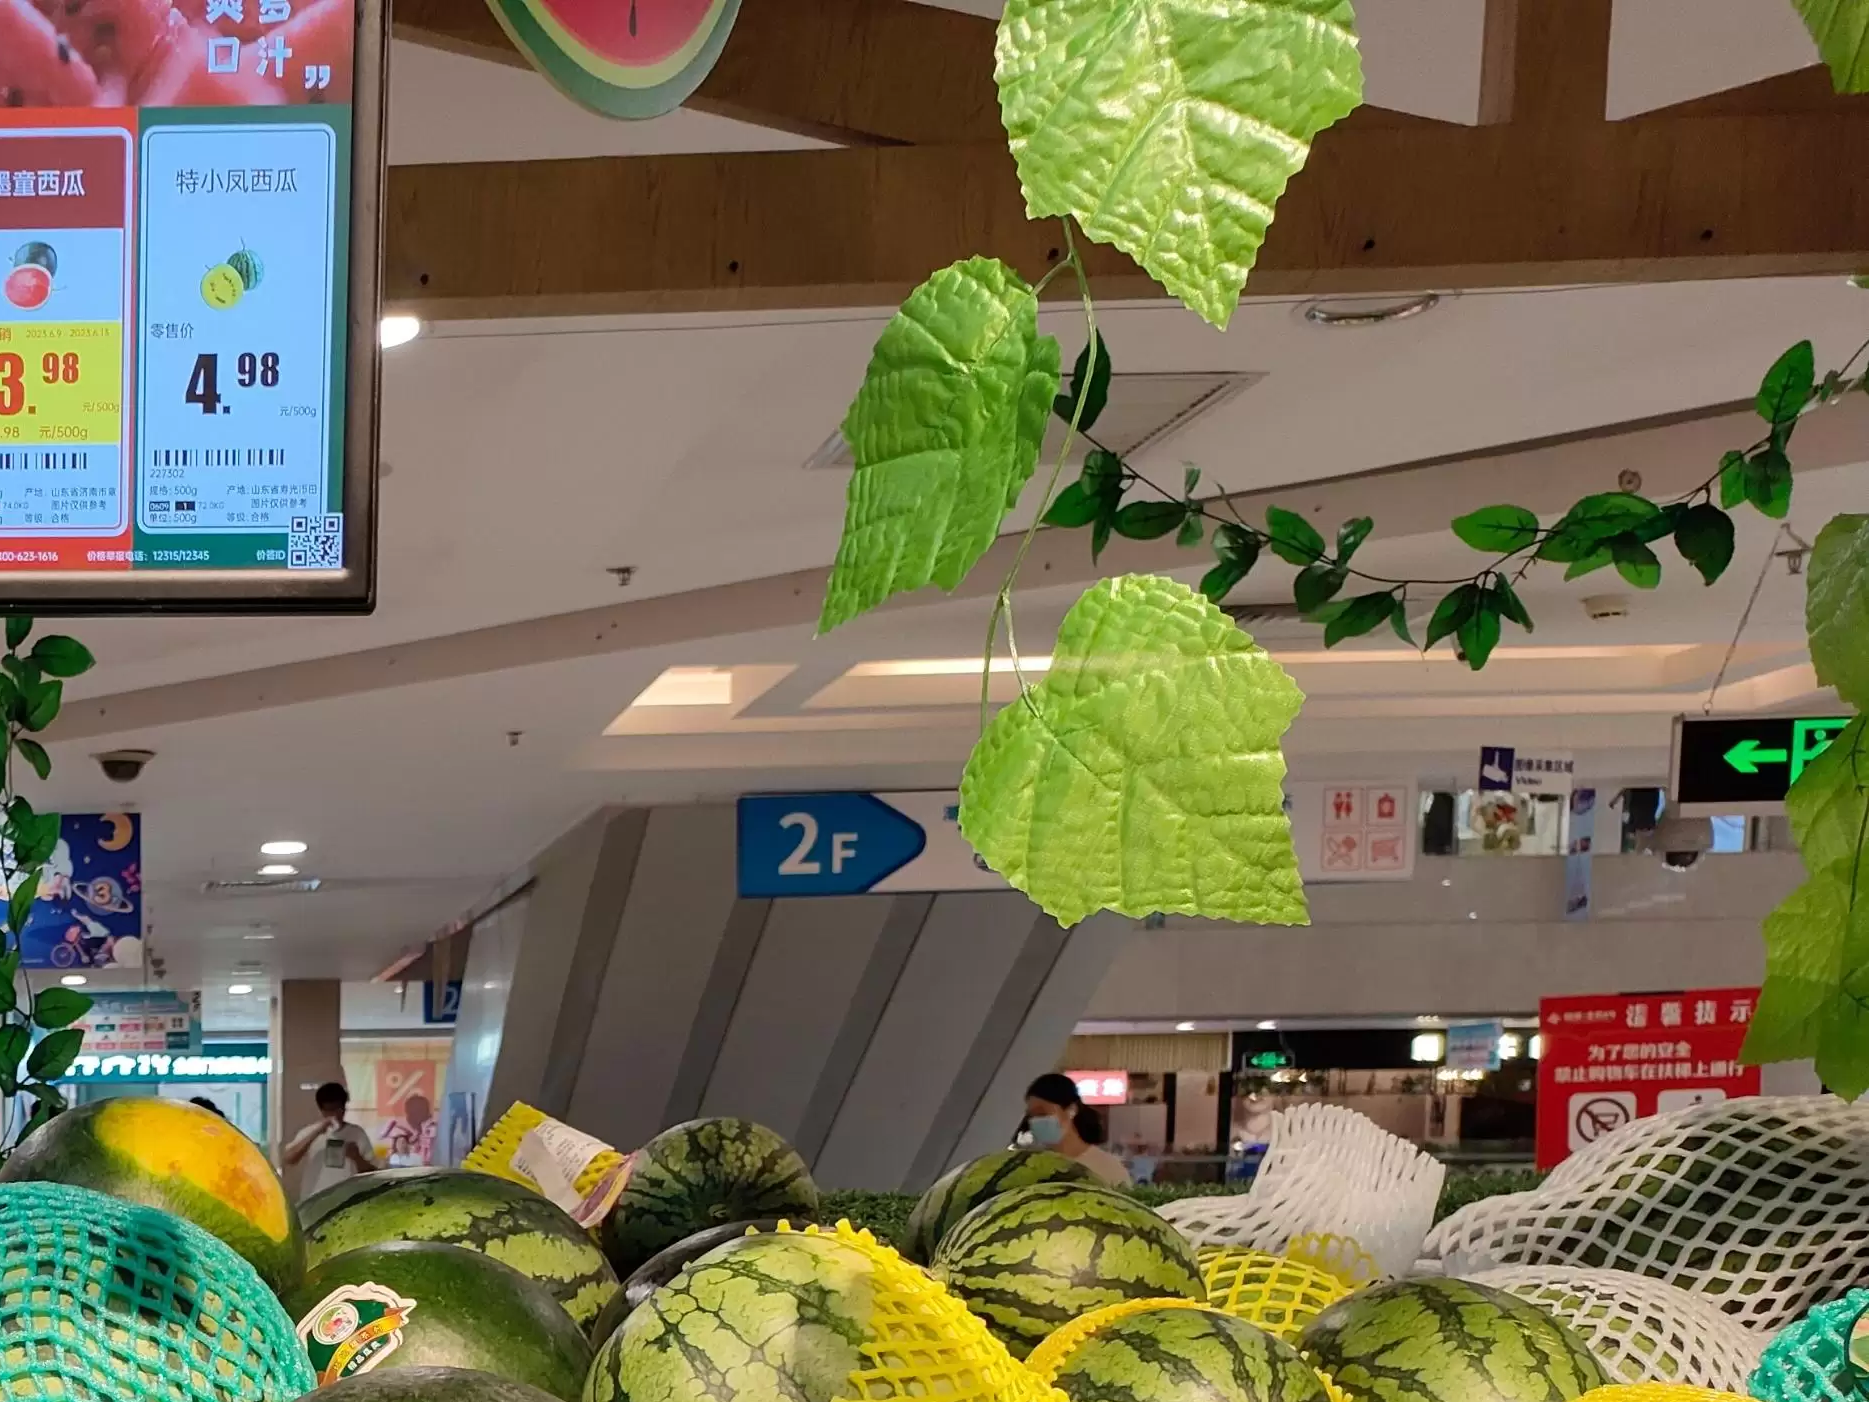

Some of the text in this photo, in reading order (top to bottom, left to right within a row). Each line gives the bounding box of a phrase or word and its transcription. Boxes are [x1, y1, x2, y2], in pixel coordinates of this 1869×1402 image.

[175, 168, 298, 194] 特小凤西瓜
[150, 323, 194, 340] 零售价
[149, 469, 185, 478] 227302
[149, 502, 170, 511] 0609
[152, 550, 210, 562] 12315/12345
[777, 812, 859, 876] 2F
